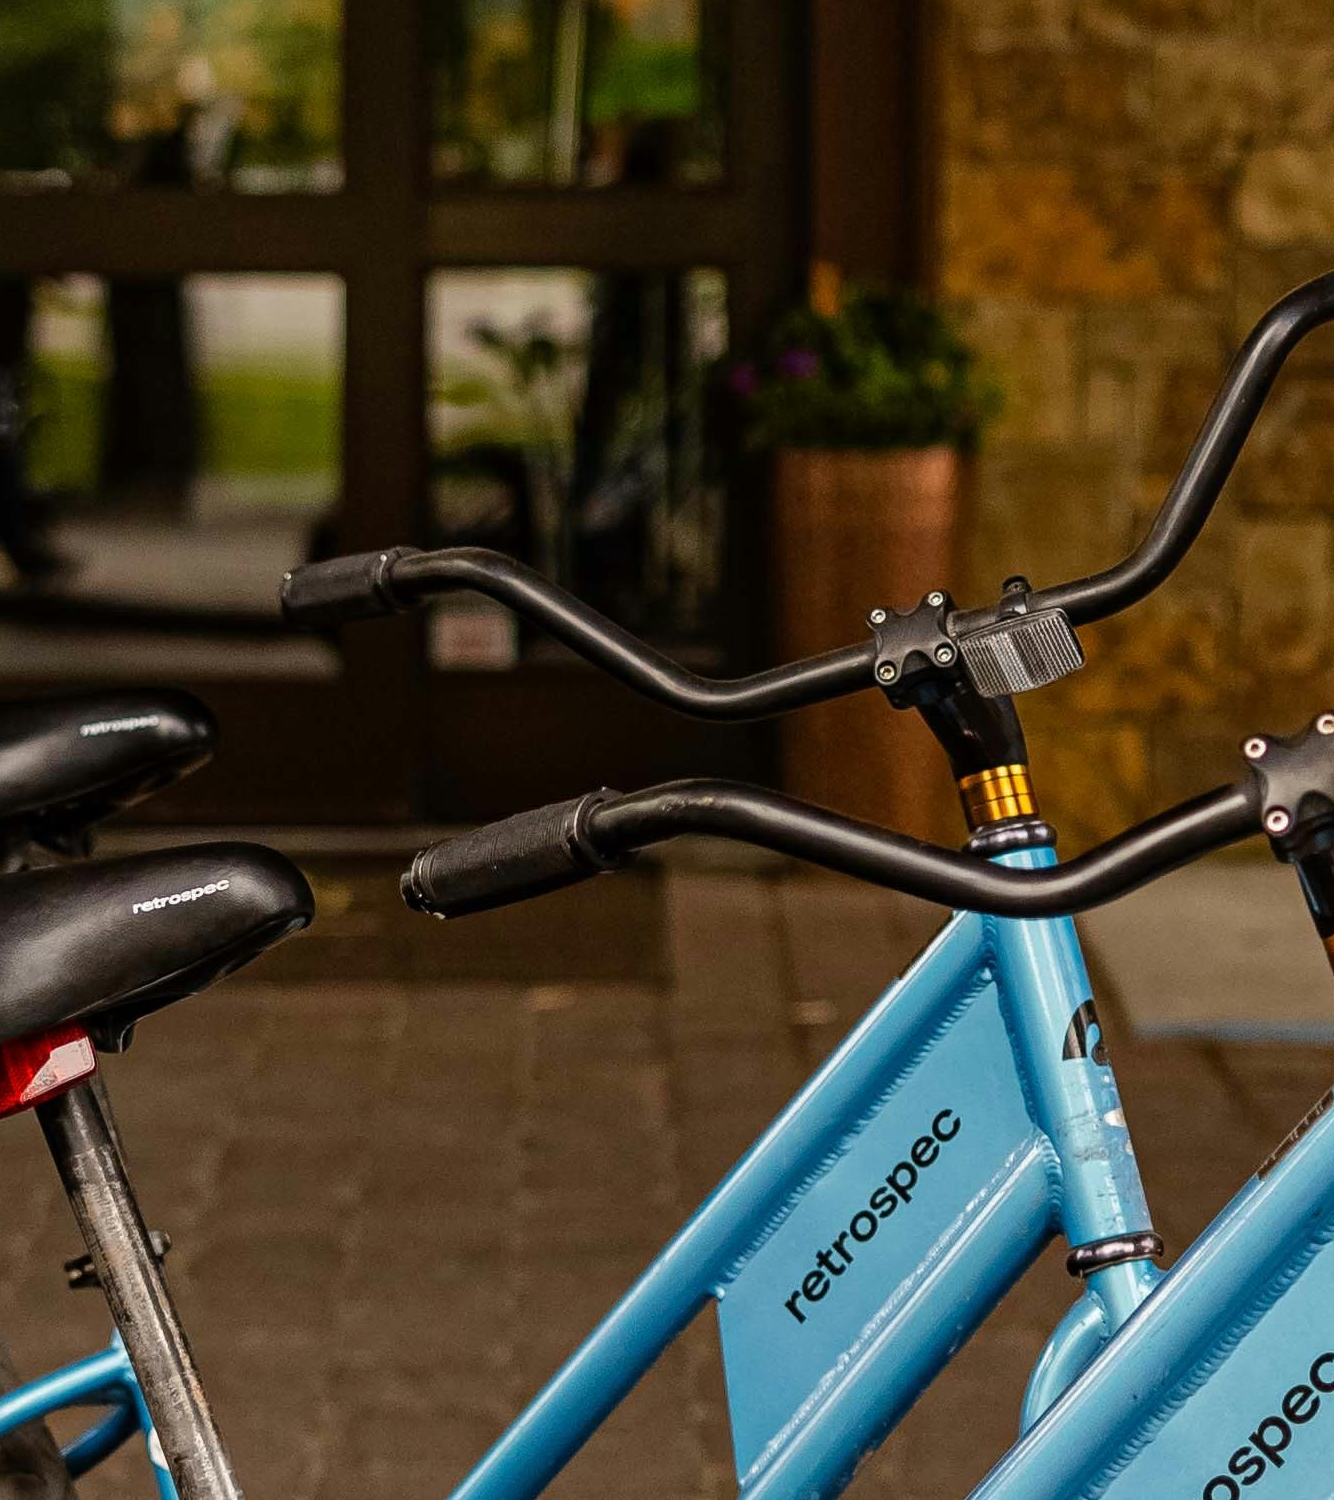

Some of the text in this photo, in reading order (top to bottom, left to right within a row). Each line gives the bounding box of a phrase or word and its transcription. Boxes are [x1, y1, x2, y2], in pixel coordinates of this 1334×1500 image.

[80, 714, 158, 737] retrospec
[132, 879, 229, 915] retrospec
[783, 1107, 962, 1325] retrospec
